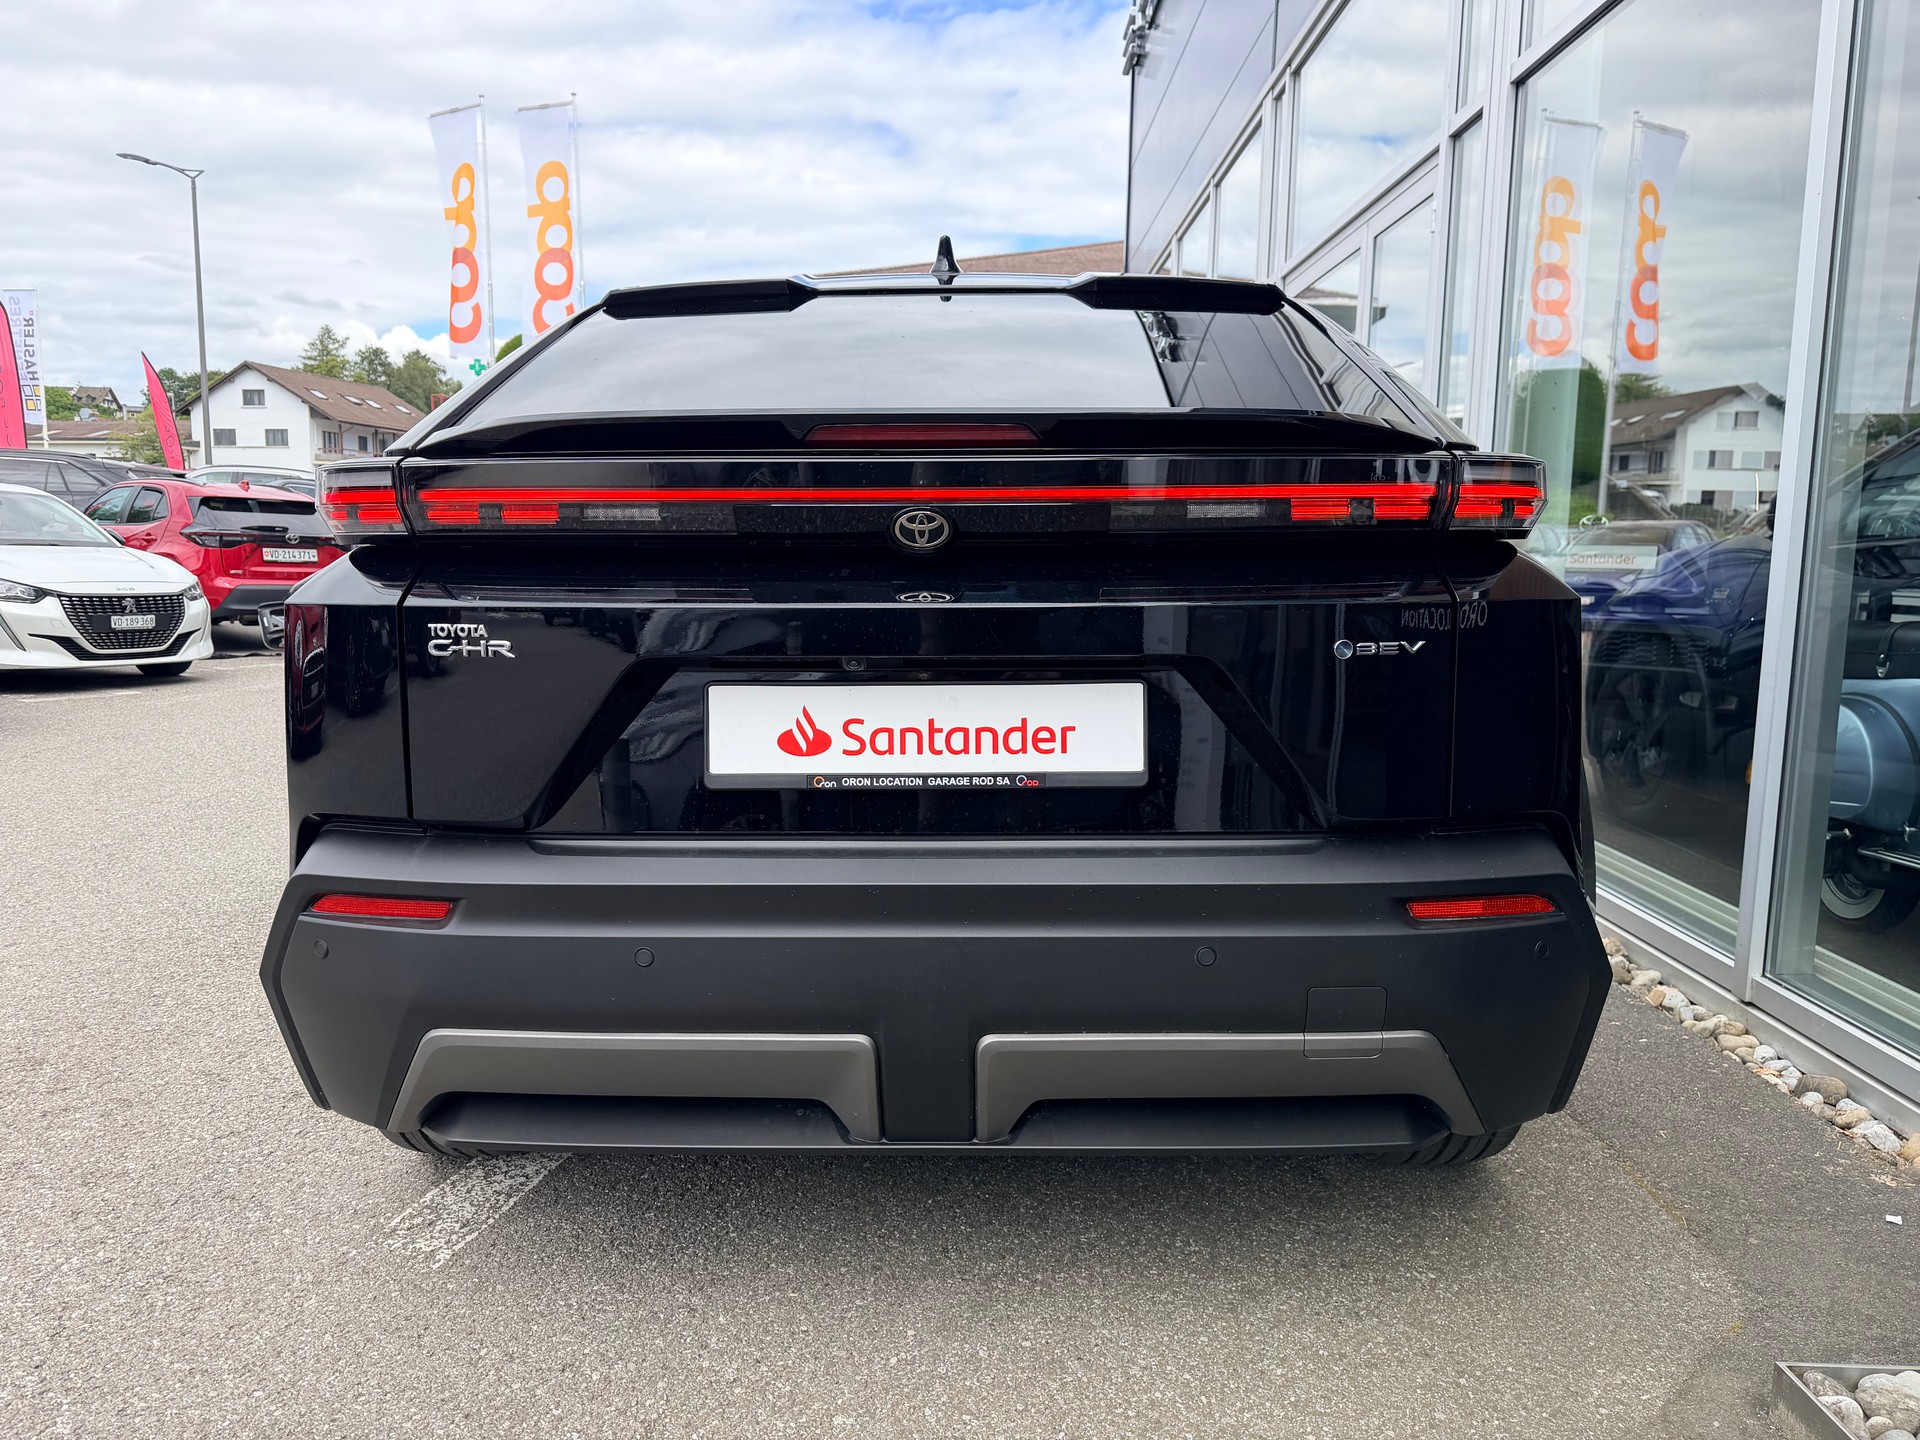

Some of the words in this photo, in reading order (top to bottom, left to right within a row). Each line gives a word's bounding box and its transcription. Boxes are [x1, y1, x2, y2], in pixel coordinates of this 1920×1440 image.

[1526, 176, 1582, 358] coop
[1569, 553, 1637, 566] Santander
[427, 623, 489, 638] TOYOTA
[427, 639, 516, 659] C-HR
[1355, 640, 1427, 656] BEV
[842, 717, 1076, 757] Santander
[841, 777, 871, 786] ORON
[873, 777, 923, 786] LOCATION
[927, 776, 970, 786] GARAGE
[972, 776, 994, 786] ROD
[996, 776, 1011, 785] SA
